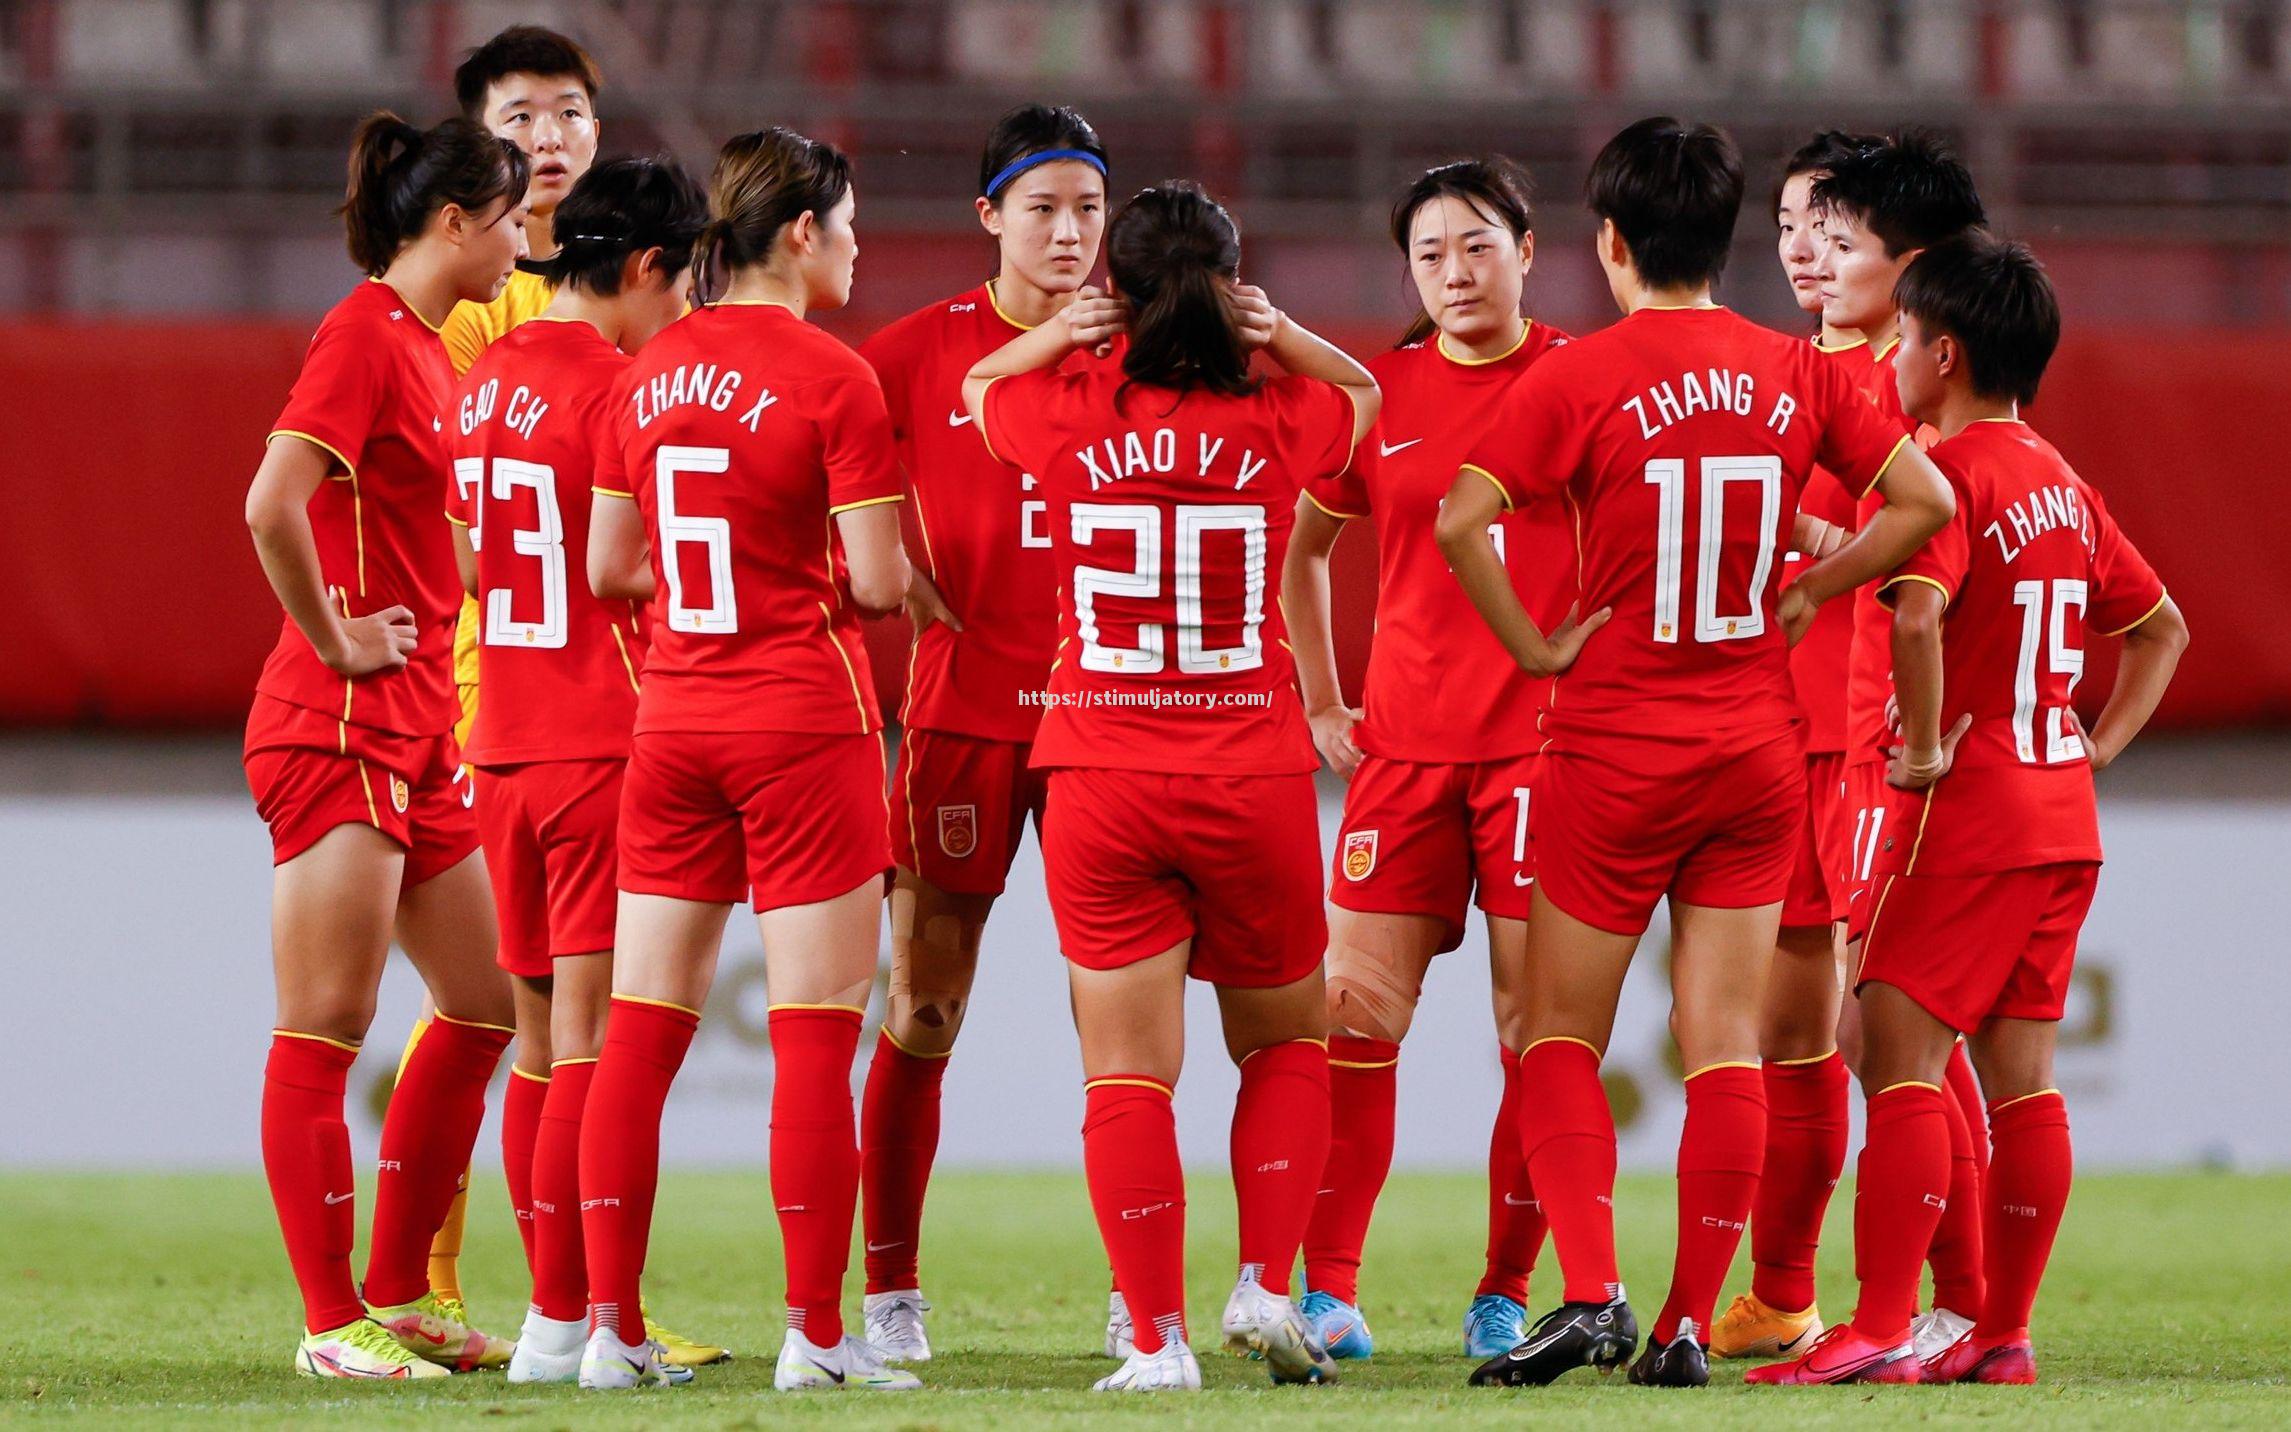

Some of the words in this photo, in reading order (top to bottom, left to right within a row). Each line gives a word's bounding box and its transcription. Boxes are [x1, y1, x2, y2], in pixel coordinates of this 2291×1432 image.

[504, 385, 549, 441] CH
[632, 363, 742, 430] ZHANG
[738, 388, 778, 433] X
[1622, 368, 1754, 440] ZHANG
[1767, 392, 1796, 435] R
[1075, 428, 1176, 491] XIAO
[1198, 432, 1224, 477] Y
[1234, 449, 1267, 491] Y
[655, 444, 738, 634] 6
[1644, 455, 1782, 644] 10
[1983, 484, 2079, 564] ZHANG
[1070, 503, 1267, 674] 20
[2012, 578, 2090, 764] 15
[943, 810, 971, 821] CFA
[1348, 835, 1374, 847] CFA
[1852, 806, 1886, 881] 11
[1702, 1216, 1745, 1232] CFA
